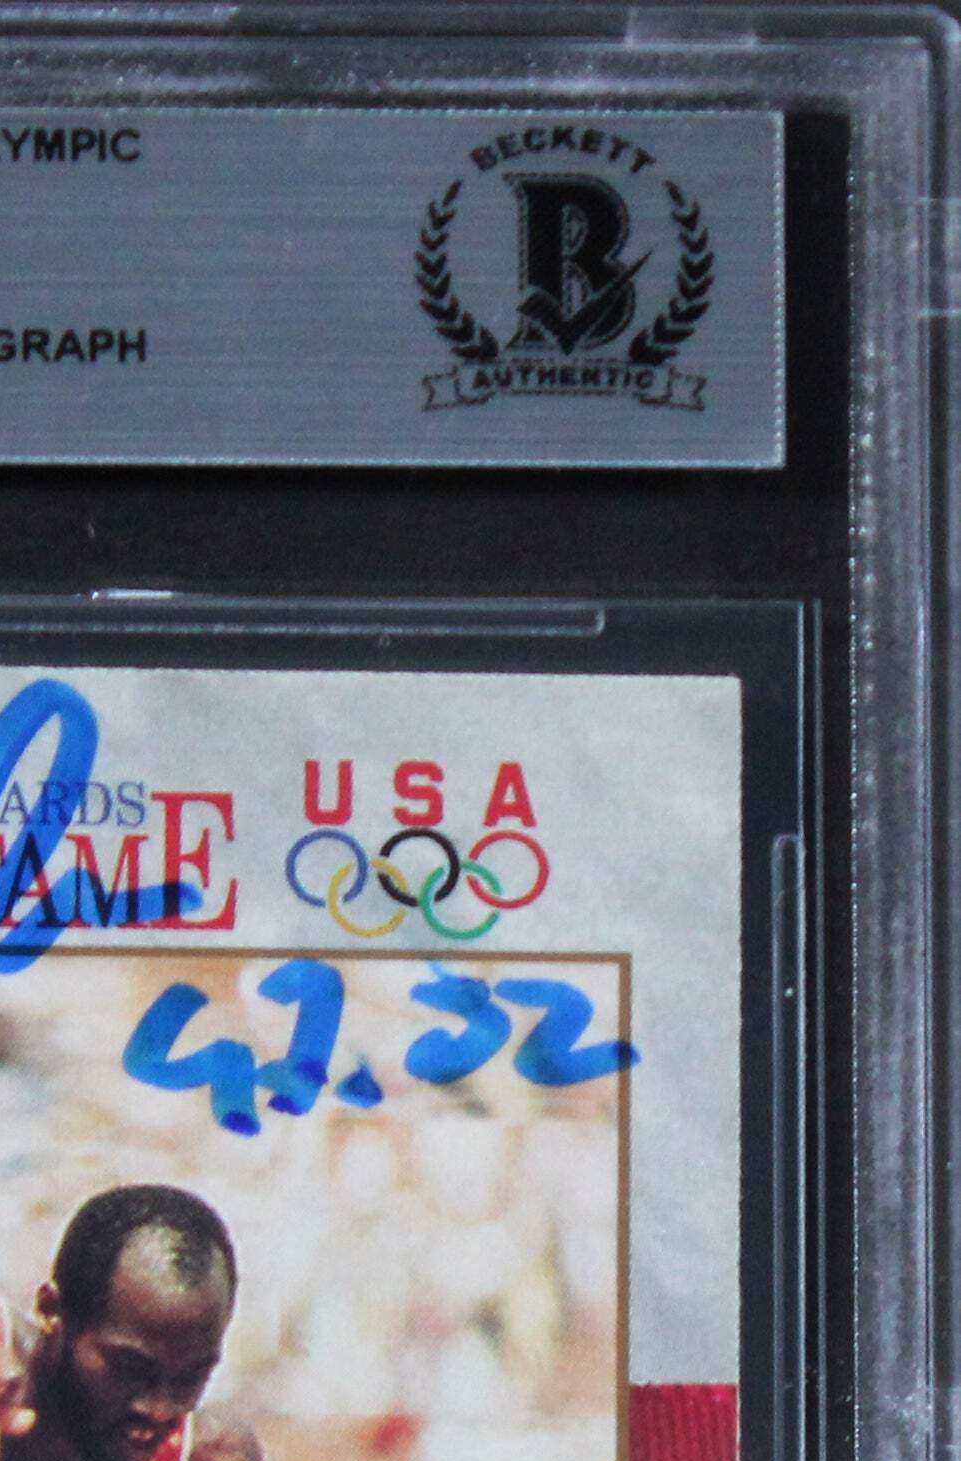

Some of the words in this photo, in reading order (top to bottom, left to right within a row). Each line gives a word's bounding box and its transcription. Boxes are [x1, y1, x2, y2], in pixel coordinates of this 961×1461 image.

[470, 127, 656, 171] BECKETT
[473, 366, 656, 391] AUTHENTIC
[303, 760, 538, 829] USA
